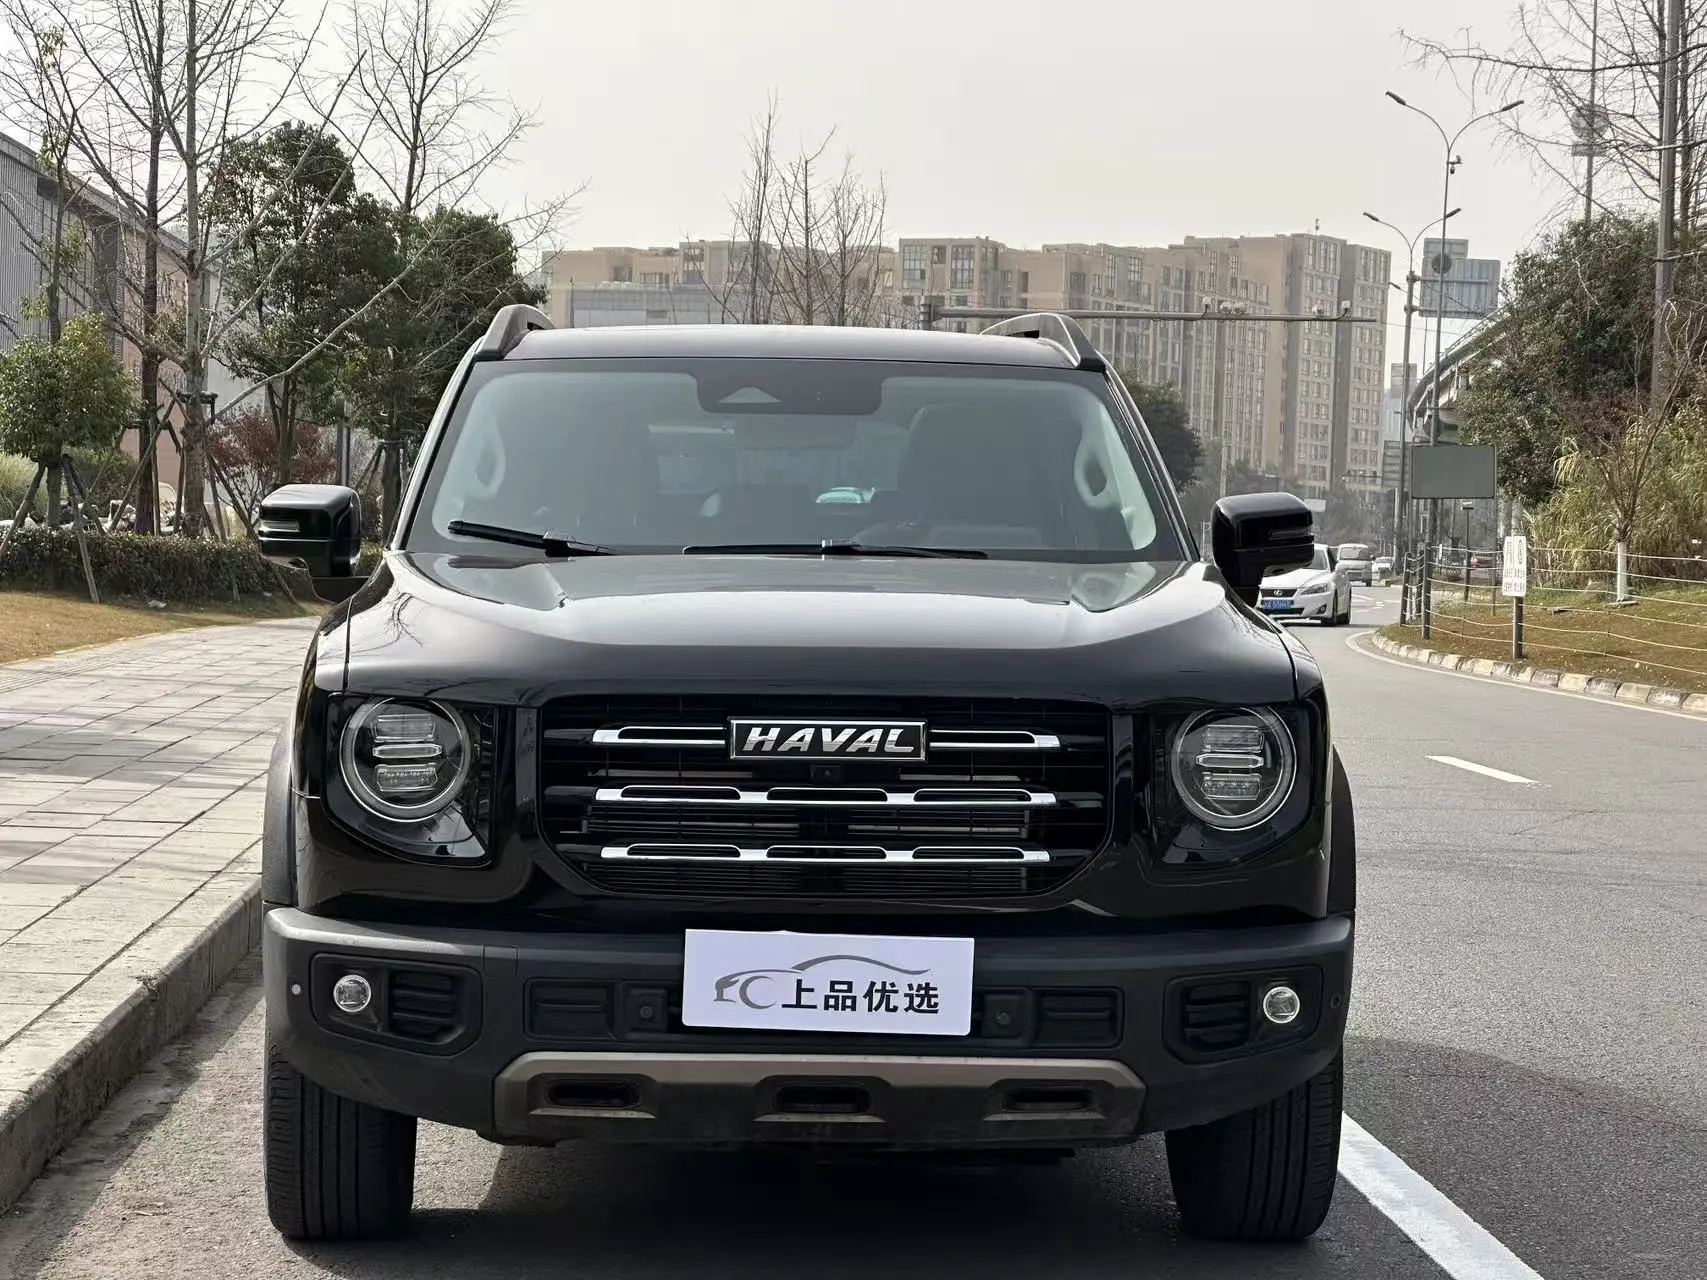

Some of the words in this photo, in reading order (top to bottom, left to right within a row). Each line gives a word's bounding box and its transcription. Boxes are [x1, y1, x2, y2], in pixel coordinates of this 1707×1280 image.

[742, 727, 915, 753] HAVAL
[781, 978, 940, 1015] 上品优选
